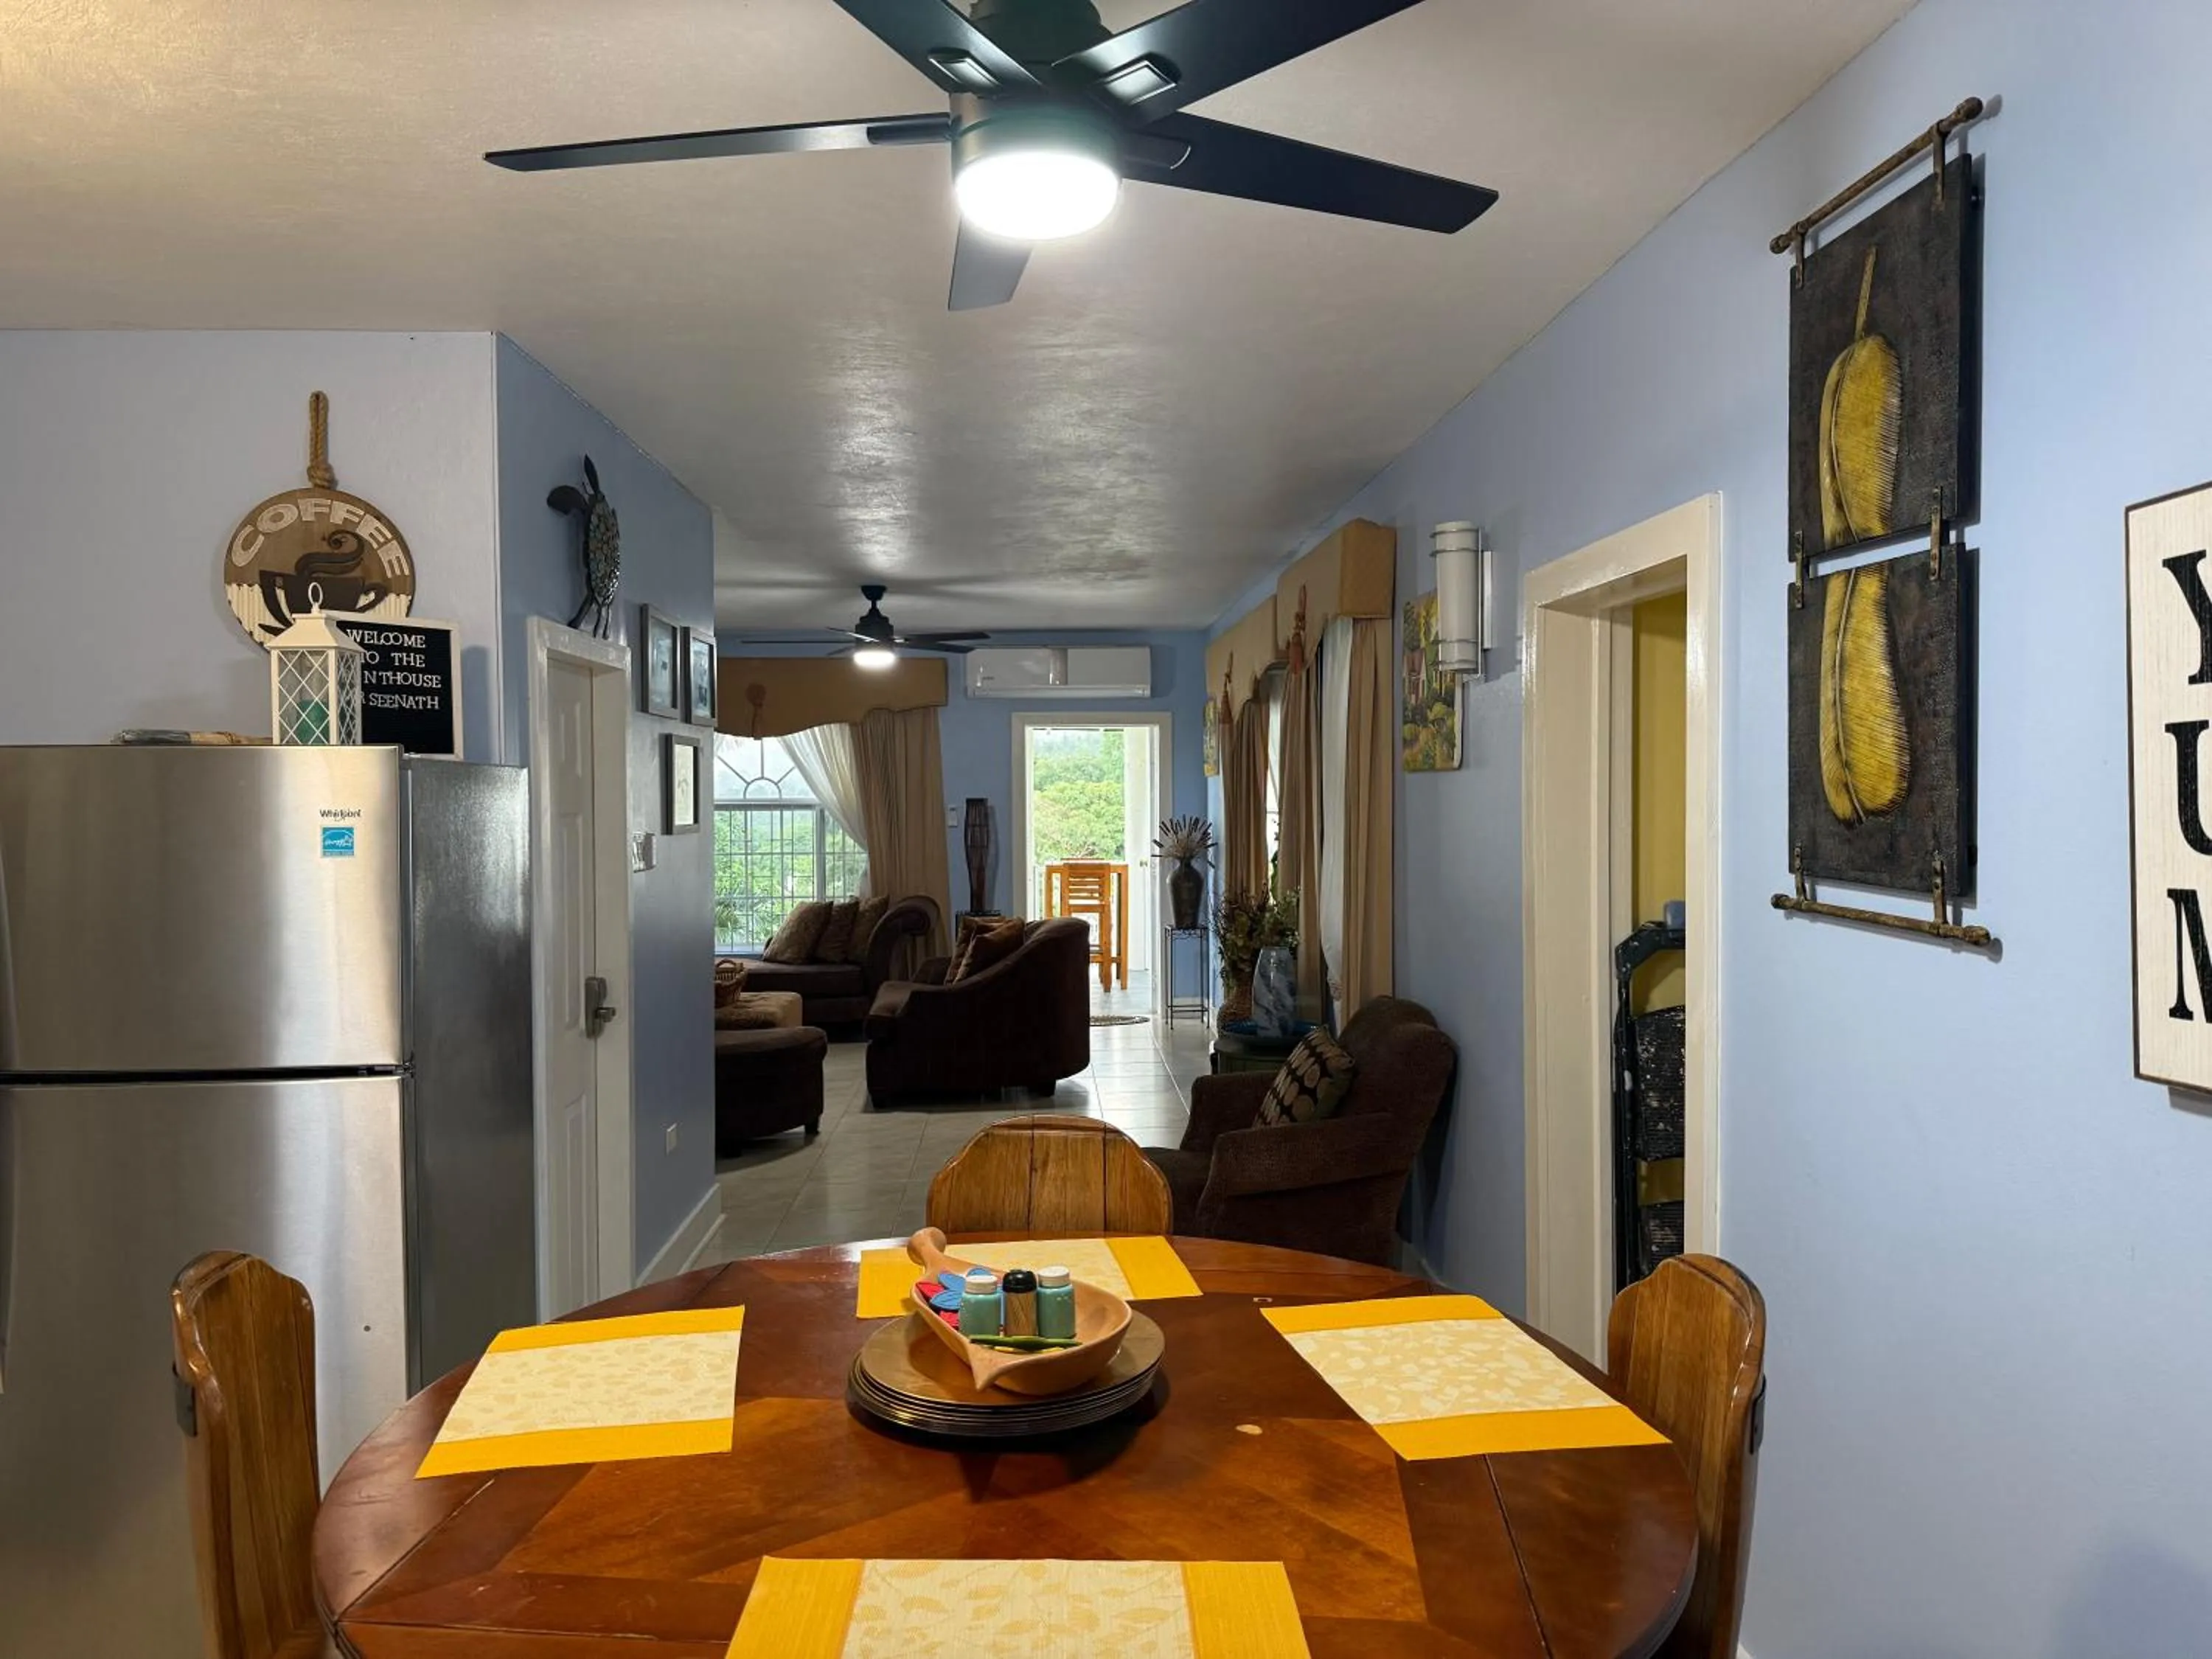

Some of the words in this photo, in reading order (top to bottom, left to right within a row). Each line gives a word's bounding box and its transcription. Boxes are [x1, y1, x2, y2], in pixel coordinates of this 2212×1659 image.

[232, 498, 408, 577] COFFEE
[347, 630, 425, 647] WELCOME
[391, 653, 425, 667] THE
[364, 671, 442, 688] NTHOUSE
[369, 693, 439, 709] SEENATH
